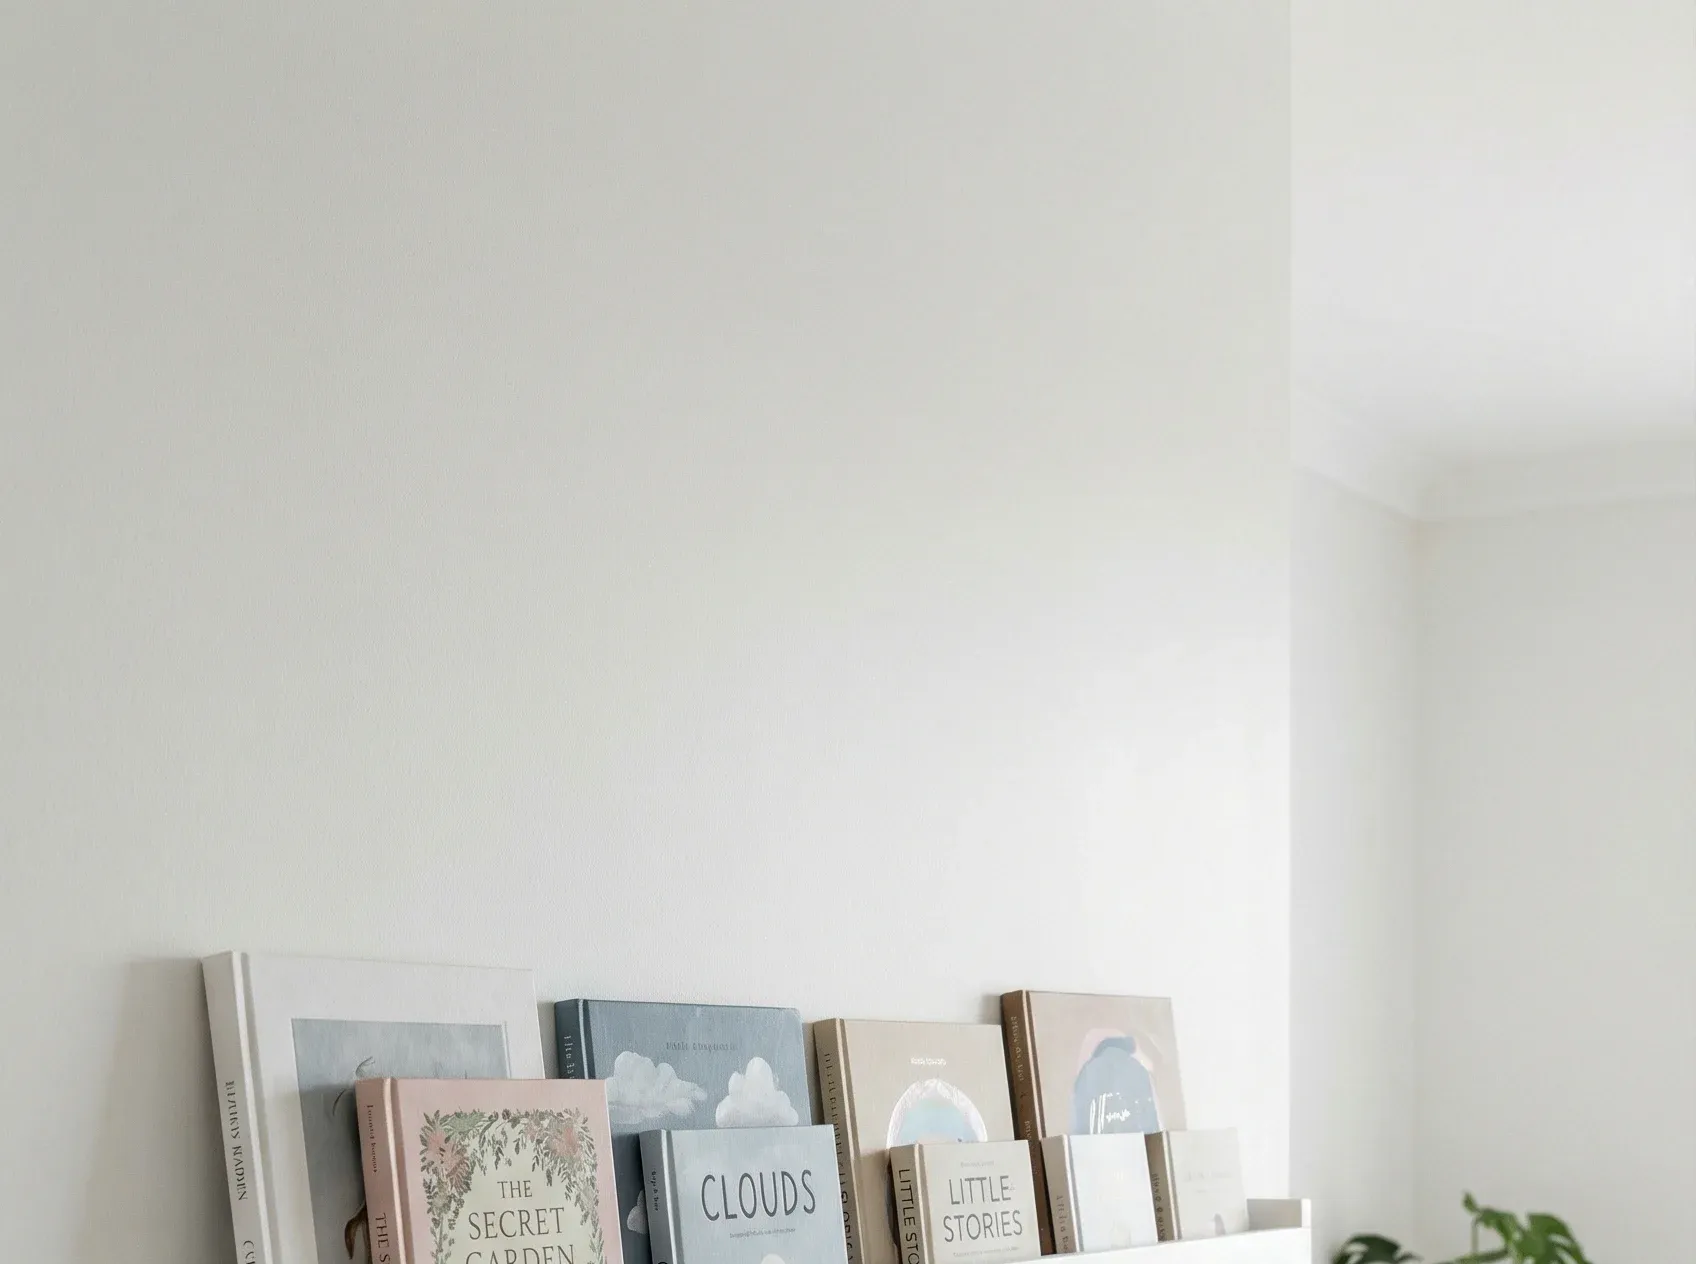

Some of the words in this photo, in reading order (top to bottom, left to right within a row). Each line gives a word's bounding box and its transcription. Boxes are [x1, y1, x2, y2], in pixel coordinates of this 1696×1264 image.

[496, 1180, 533, 1199] THE
[701, 1169, 816, 1222] CLOUDS
[898, 1169, 916, 1226] LITTLE
[948, 1175, 1012, 1205] LITTLE
[375, 1212, 390, 1248] THE
[468, 1207, 565, 1240] SECRET
[943, 1209, 1023, 1243] STORIES
